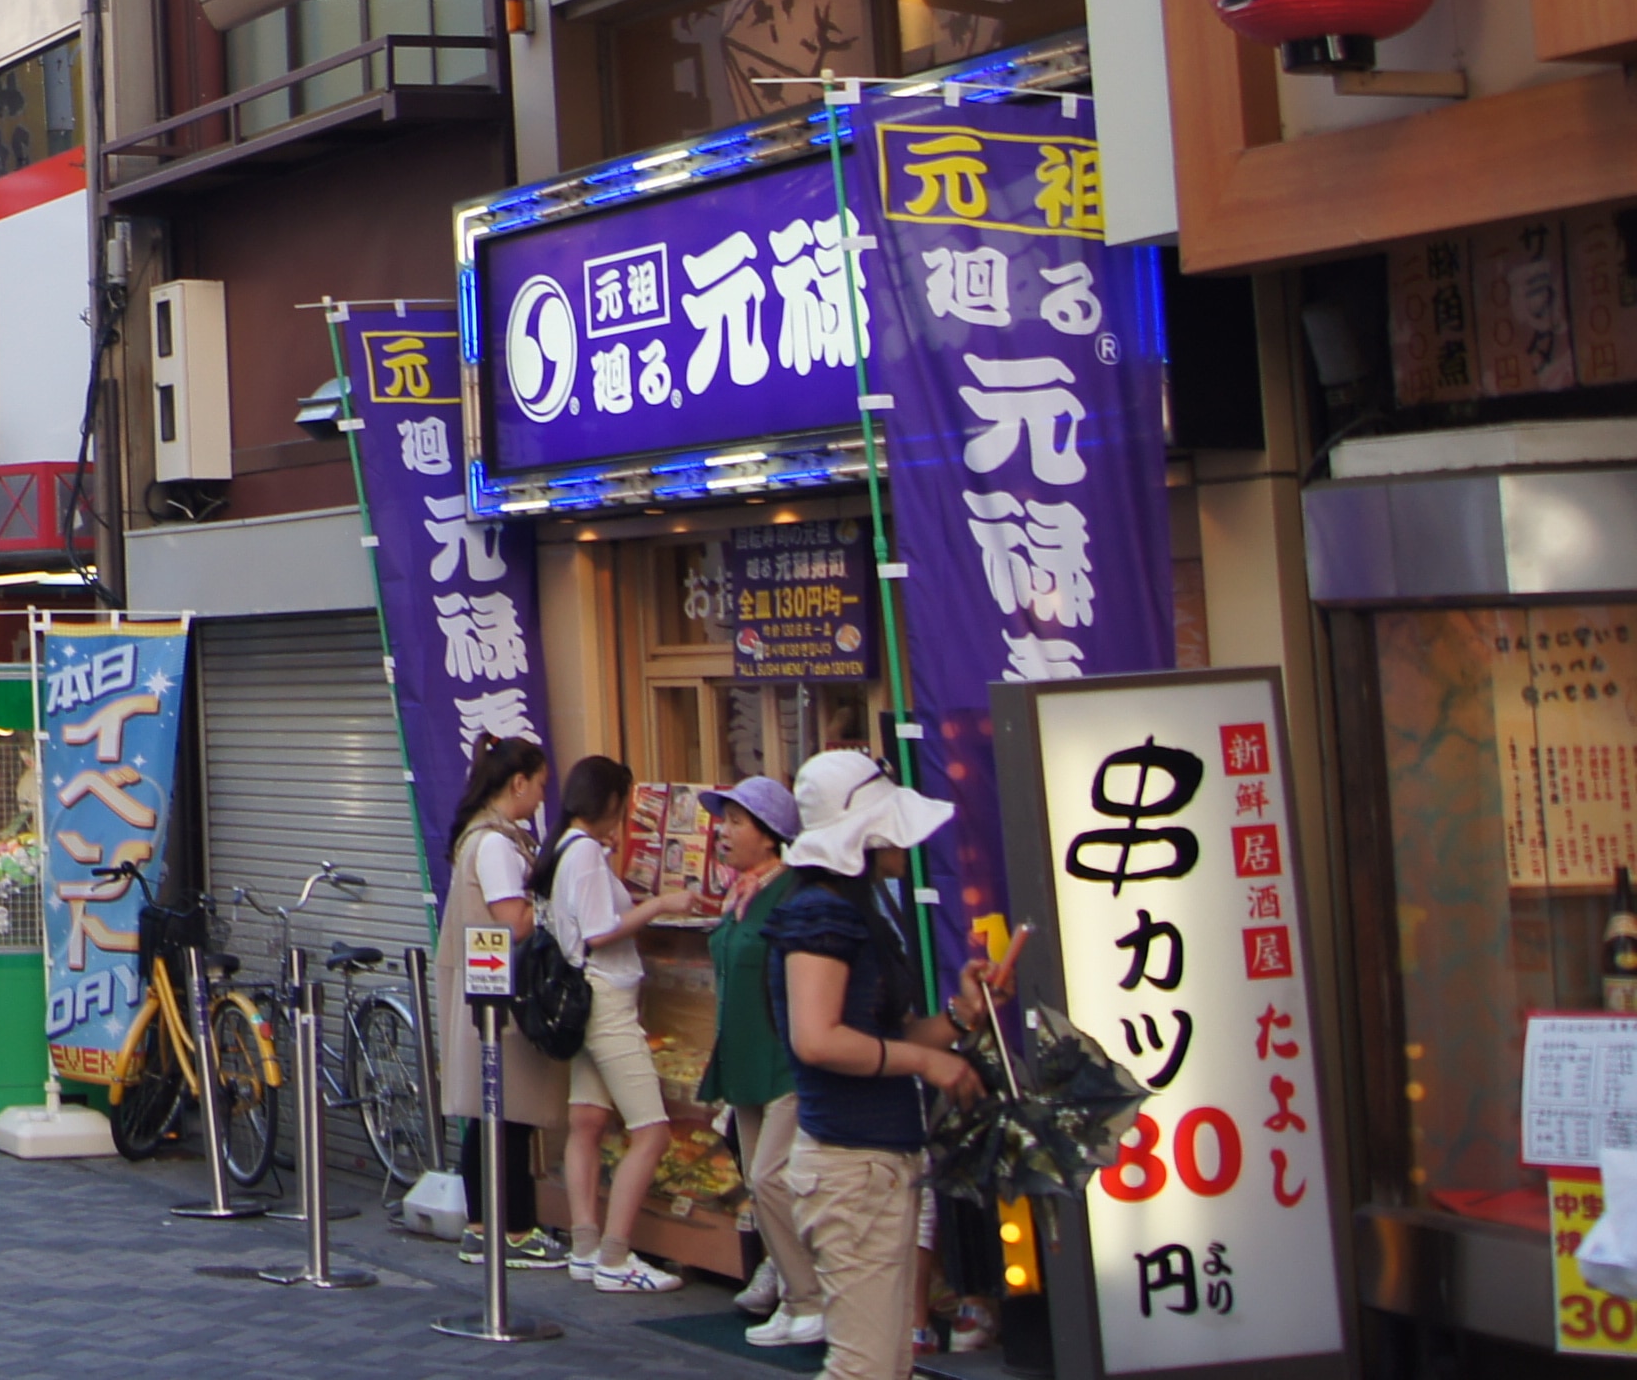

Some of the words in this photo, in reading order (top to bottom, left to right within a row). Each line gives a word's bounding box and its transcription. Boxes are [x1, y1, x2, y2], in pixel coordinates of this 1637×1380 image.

[903, 133, 1103, 228] 元祖
[591, 344, 673, 416] 廻る
[681, 208, 873, 396] 元禄
[593, 262, 663, 322] 元祖
[923, 245, 1103, 336] 廻る
[775, 549, 847, 580] 元禄寿司
[775, 585, 859, 618] 130円均一
[48, 645, 136, 713] 本日
[58, 694, 161, 970] イベント
[1229, 734, 1285, 972] 新鮮居酒屋
[474, 932, 503, 946] 入口
[1066, 735, 1203, 1090] 串カツ
[47, 968, 141, 1036] DAY
[1256, 1004, 1307, 1208] たよし
[1135, 1245, 1199, 1317] 円
[1203, 1243, 1233, 1314] より
